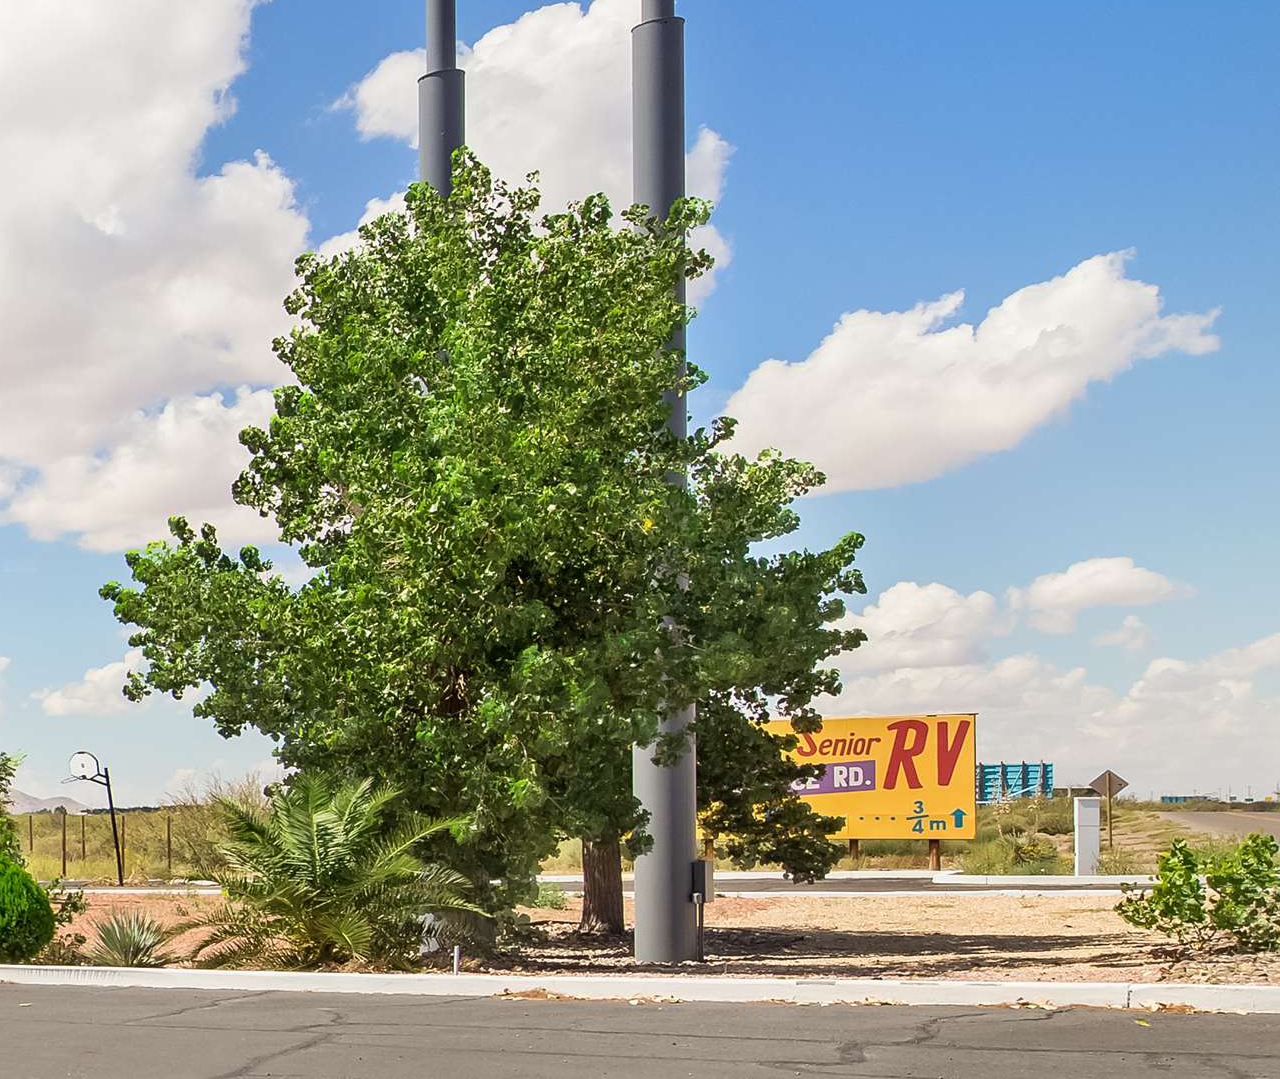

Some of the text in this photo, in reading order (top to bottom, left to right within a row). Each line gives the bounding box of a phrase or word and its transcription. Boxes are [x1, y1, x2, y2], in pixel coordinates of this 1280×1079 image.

[796, 719, 970, 790] Senior RV
[833, 765, 872, 788] RD.
